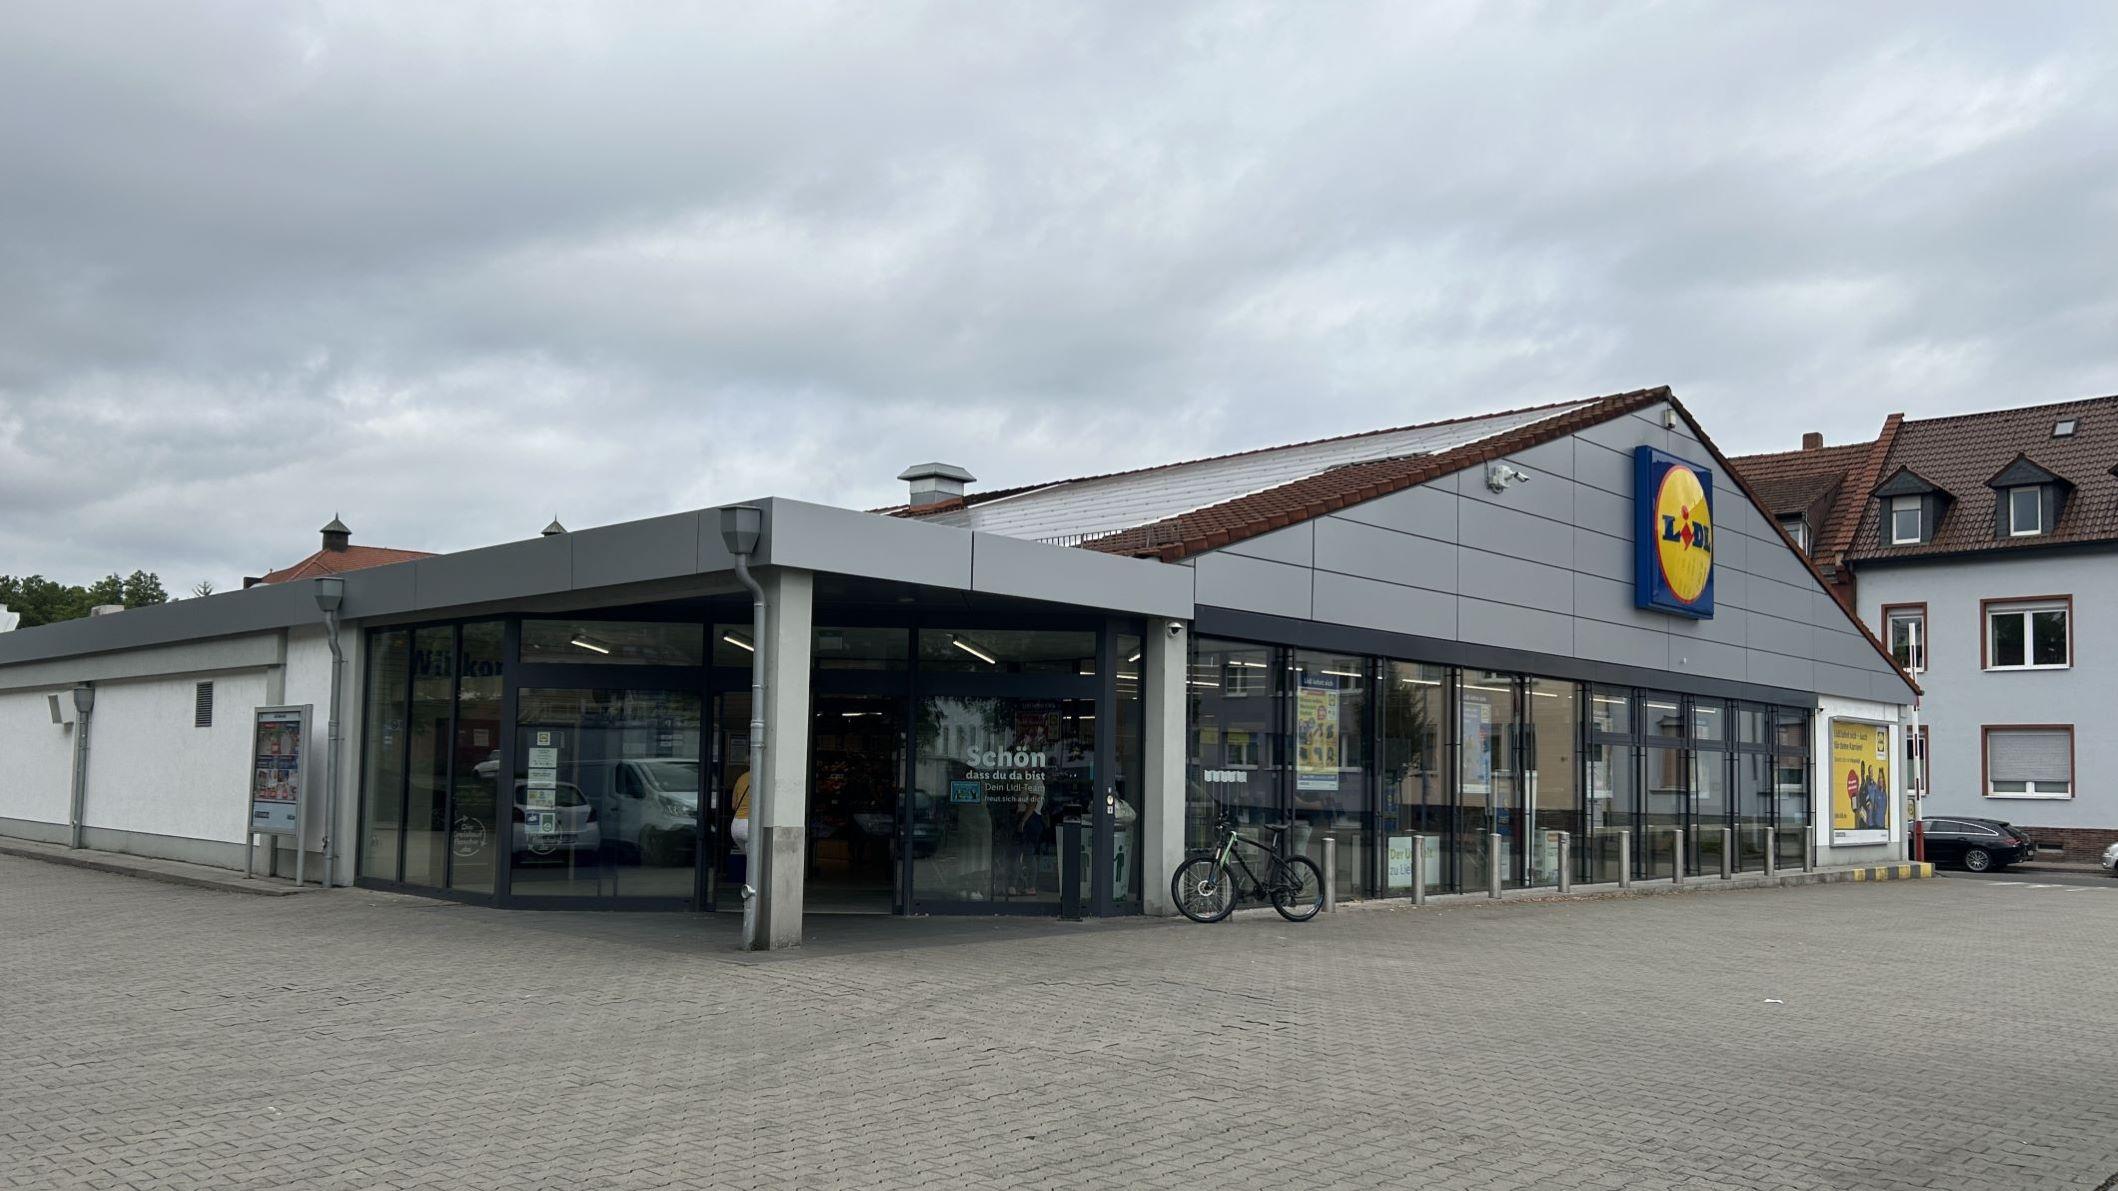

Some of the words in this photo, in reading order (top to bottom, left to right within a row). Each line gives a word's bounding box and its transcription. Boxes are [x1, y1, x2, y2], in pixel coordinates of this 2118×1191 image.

[966, 745, 1046, 768] Schön
[966, 770, 989, 780] dass
[992, 770, 1007, 780] du
[1009, 770, 1023, 780] da
[1025, 770, 1046, 780] bist
[985, 783, 1004, 792] Dein
